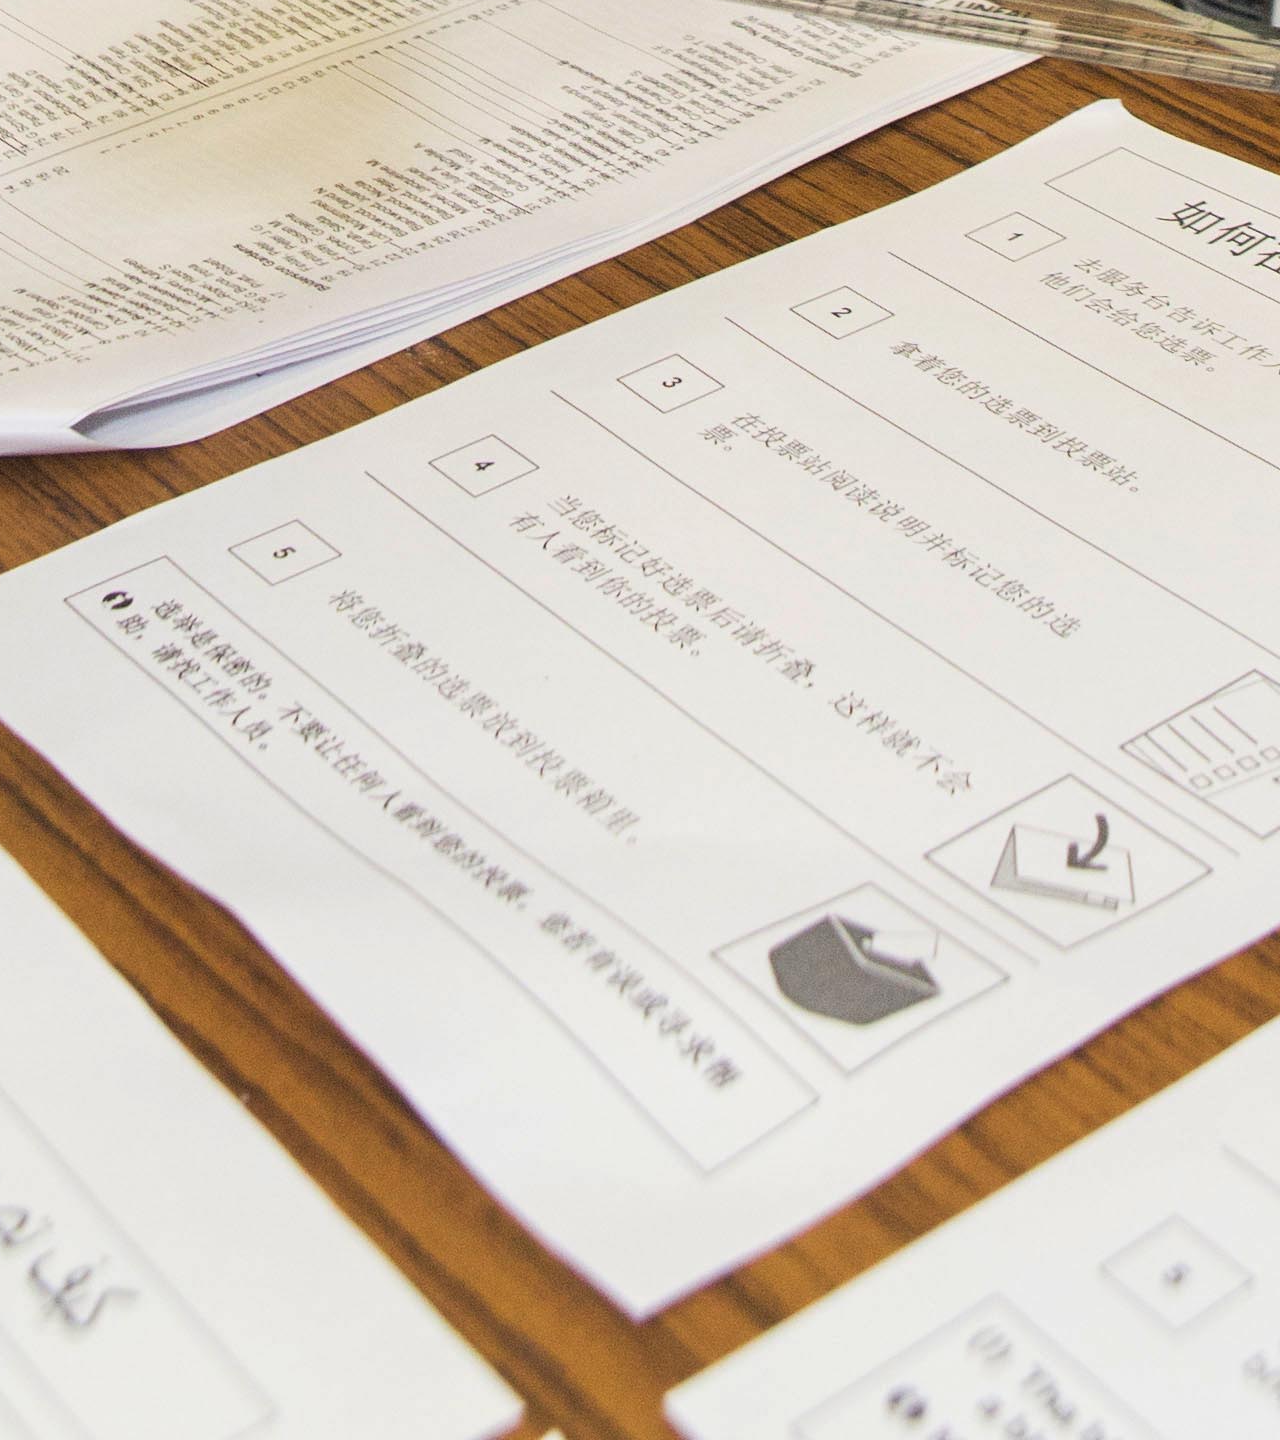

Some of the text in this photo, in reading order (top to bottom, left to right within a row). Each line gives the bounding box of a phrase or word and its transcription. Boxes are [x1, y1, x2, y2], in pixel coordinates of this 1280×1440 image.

[1007, 232, 1024, 242] 1
[831, 307, 853, 319] 2
[1039, 271, 1217, 372] 他们会给您选票。
[661, 376, 683, 389] 3
[890, 341, 1139, 493] 拿着您的选票到投票站。
[699, 423, 739, 452] 票。
[475, 461, 495, 472] 4
[730, 412, 1080, 639] 在投票站阅读说明并标记您的选
[272, 546, 296, 559] 5
[509, 511, 703, 656] 有人看到你的投票。
[547, 494, 971, 796] 当您标记好选票后请折叠，这样就不会
